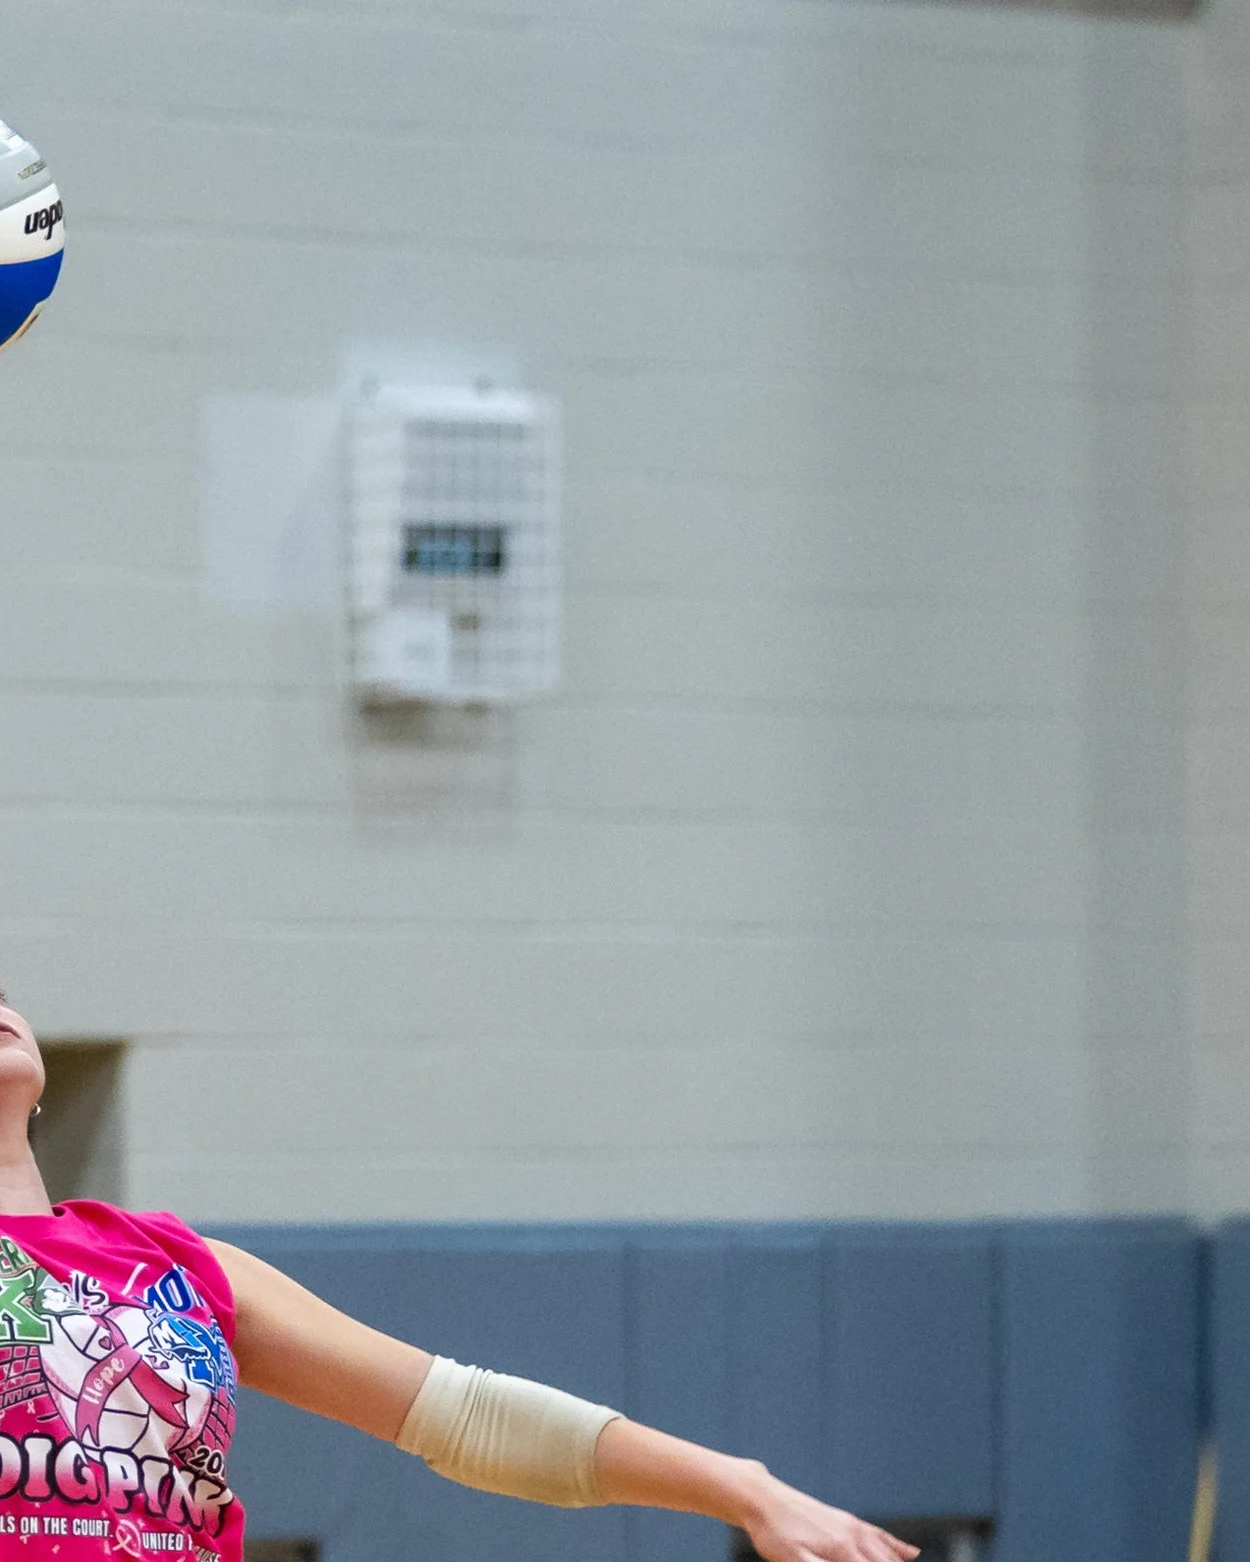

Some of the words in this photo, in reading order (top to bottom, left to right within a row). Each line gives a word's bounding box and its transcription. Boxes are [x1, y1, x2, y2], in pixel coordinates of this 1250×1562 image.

[82, 1357, 125, 1405] Hope
[187, 1446, 225, 1476] 20
[100, 1447, 233, 1538] PINK
[20, 1516, 38, 1534] ON
[43, 1517, 68, 1535] THE
[72, 1518, 113, 1538] COURT.
[142, 1532, 184, 1551] UNITED
